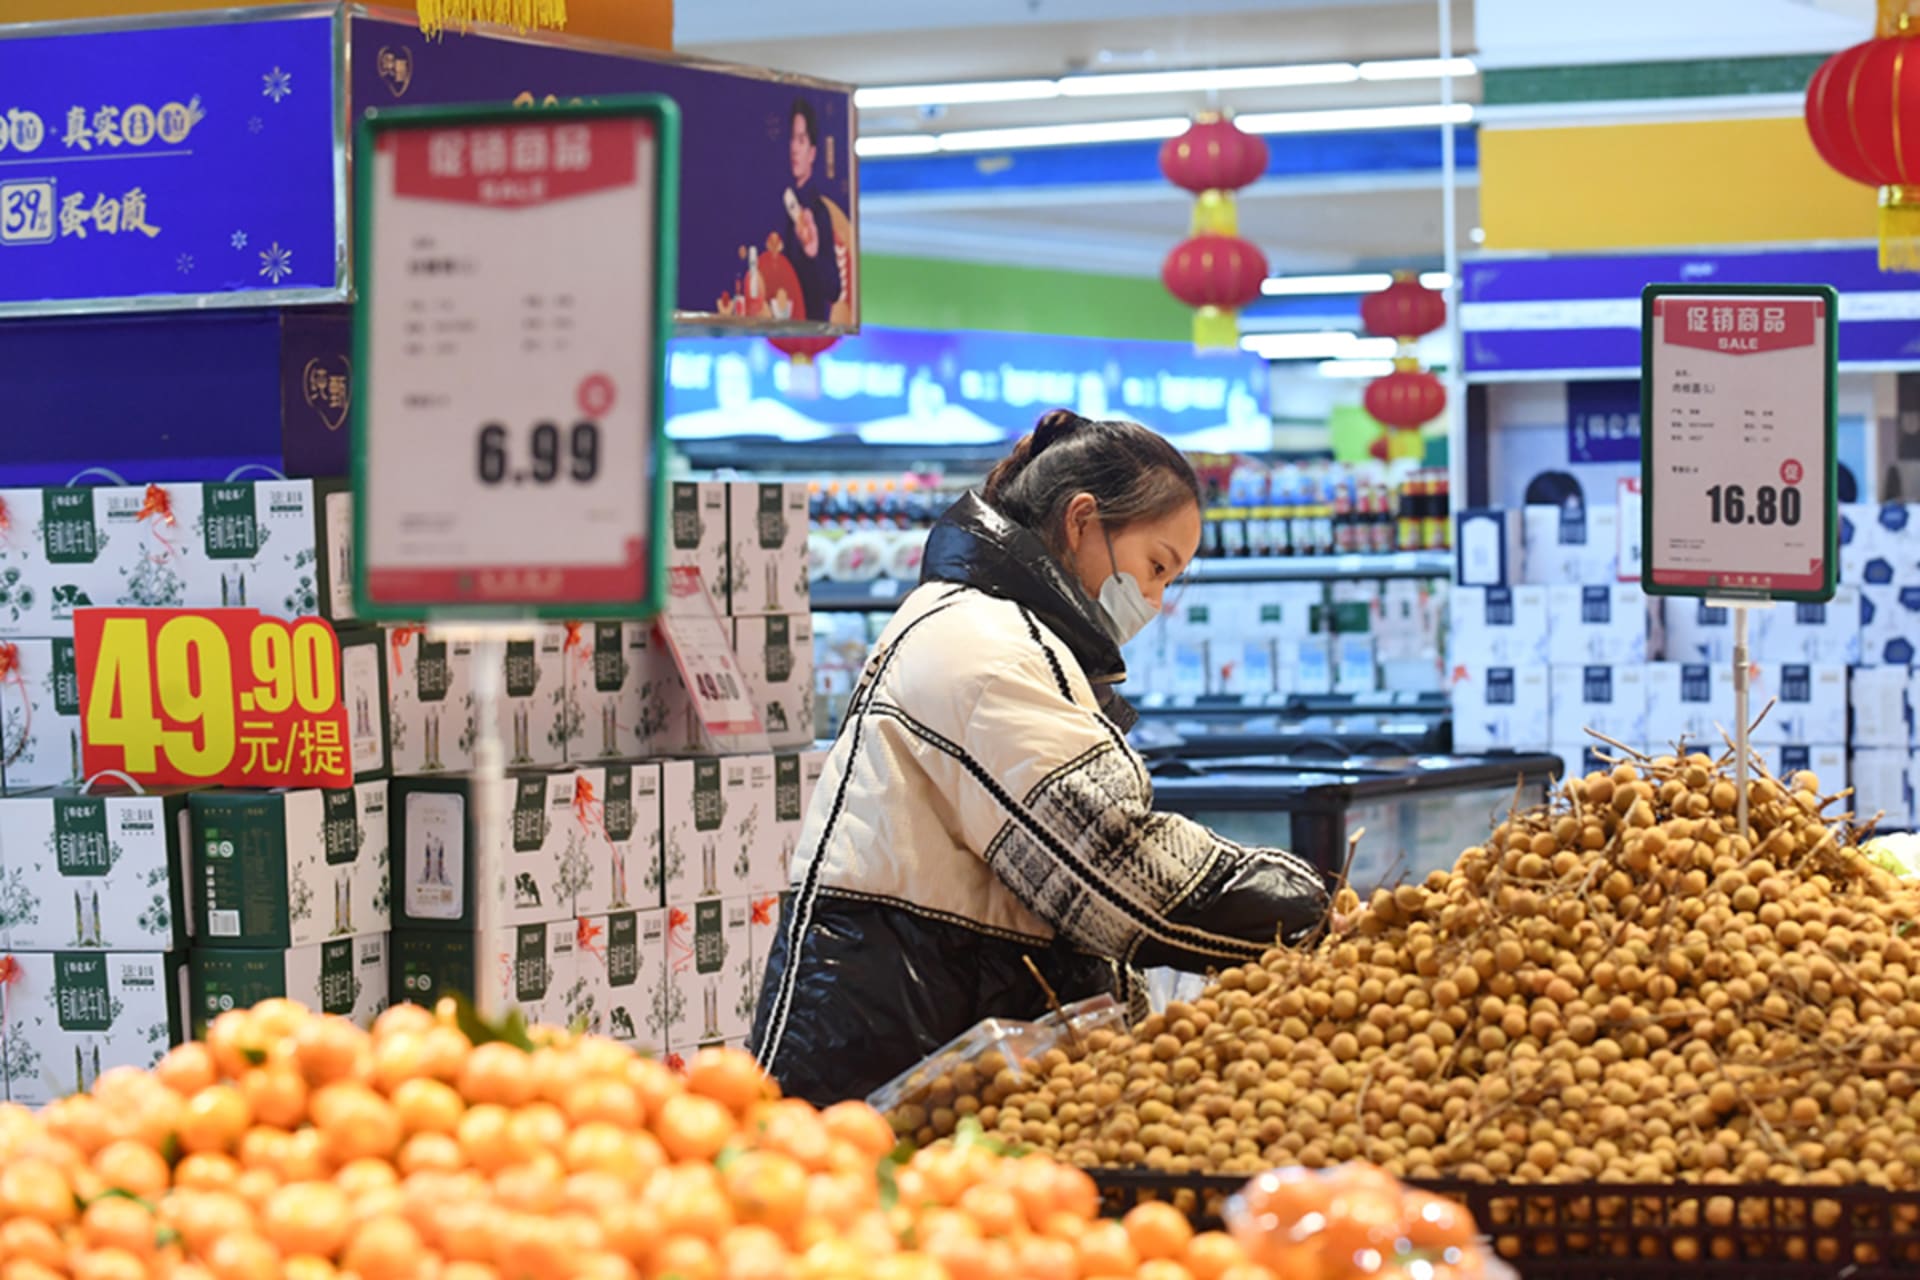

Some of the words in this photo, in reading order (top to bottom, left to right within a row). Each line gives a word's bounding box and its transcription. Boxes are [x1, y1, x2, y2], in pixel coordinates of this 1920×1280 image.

[428, 125, 592, 177] 促销商品
[59, 187, 161, 239] 蛋白质
[1686, 306, 1787, 333] 促销商品
[1717, 337, 1759, 350] SALE
[476, 418, 602, 487] 6.99
[1705, 484, 1801, 527] 16.80
[86, 615, 336, 777] 49.90
[240, 720, 345, 776] 元/提
